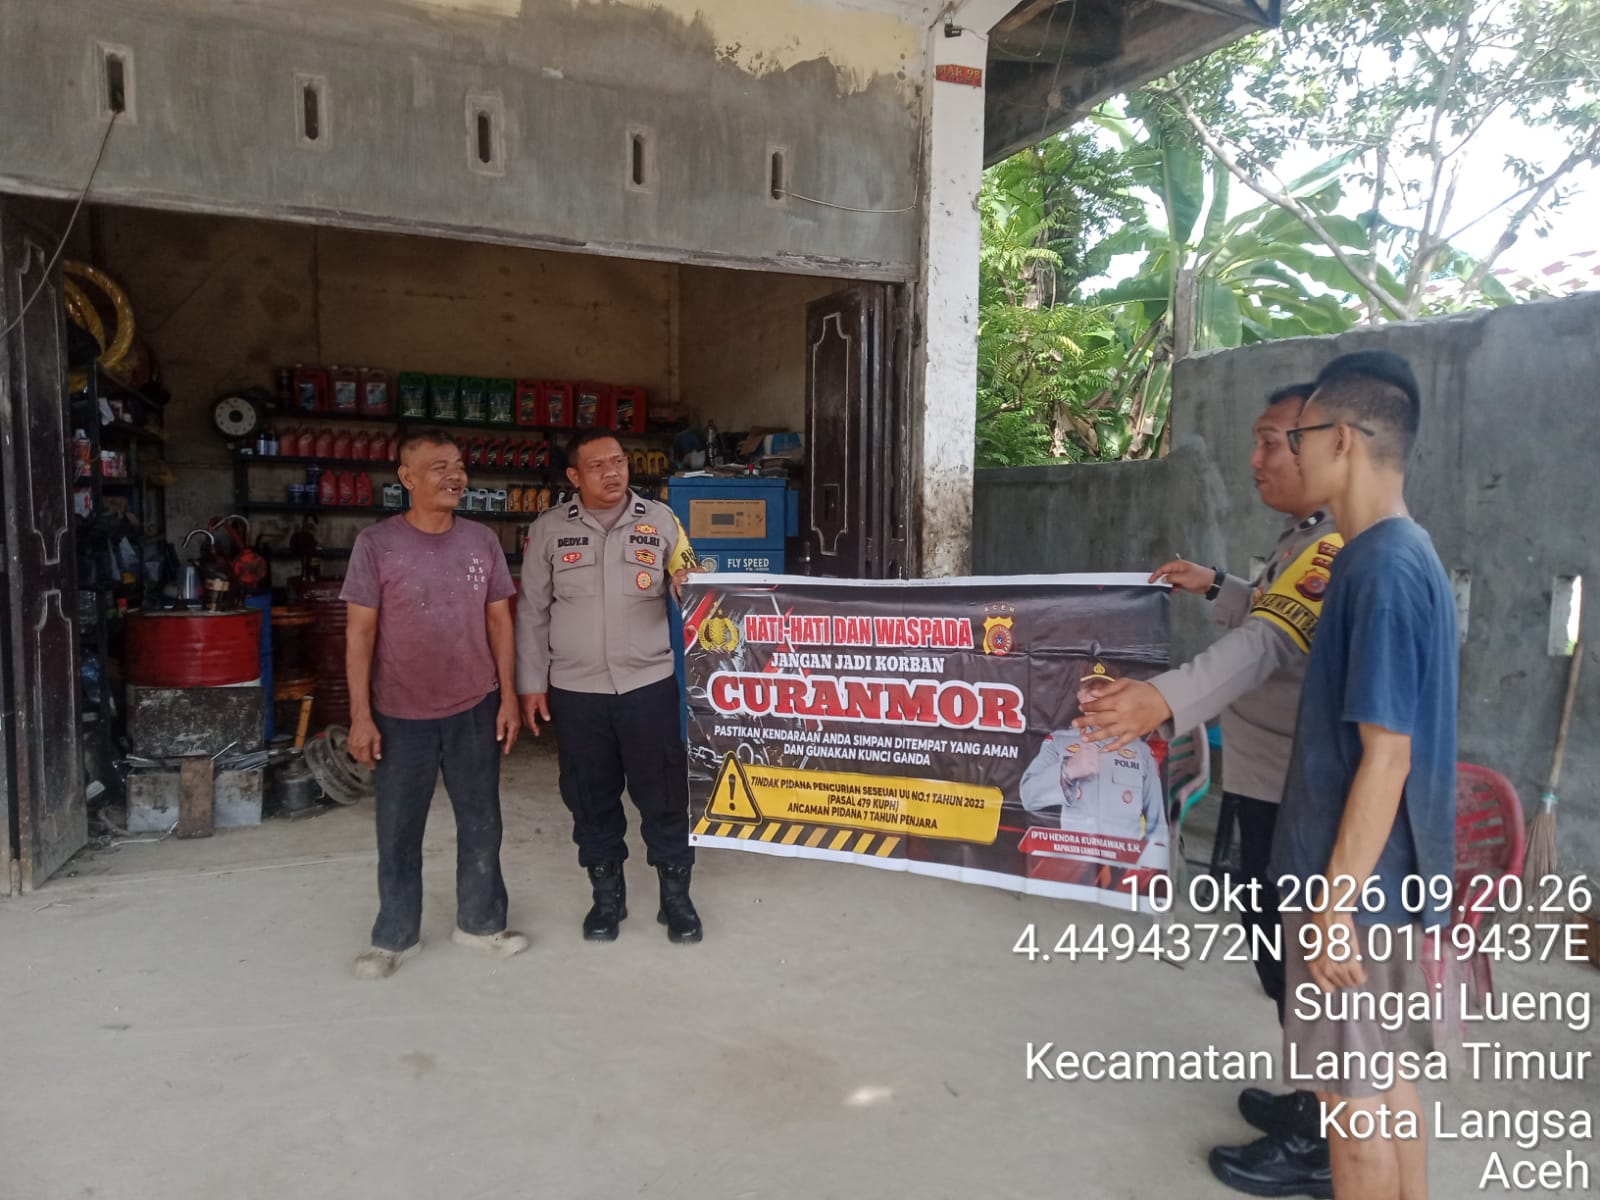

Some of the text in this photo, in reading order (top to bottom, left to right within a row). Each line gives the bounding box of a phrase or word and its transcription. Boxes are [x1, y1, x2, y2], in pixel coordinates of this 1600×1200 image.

[629, 535, 660, 547] POLRI
[727, 558, 770, 569] FLY SPEED
[984, 604, 1015, 613] ACEH
[744, 614, 831, 645] HATI-HATI
[833, 616, 873, 647] DAN
[874, 616, 974, 649] WASPADA
[771, 652, 945, 673] JANGAN JADI KORBAN
[707, 671, 1026, 734] CURANMOR
[714, 725, 1018, 759] PASTIKAN KENDARAAN ANDA SIMPAN DITEMPAT YANG AMAN
[784, 743, 931, 766] DAN GUNAKAN KUNCI GANDA
[1114, 759, 1140, 770] POLRI
[751, 776, 779, 788] TINDAK
[780, 778, 811, 790] PIDANA
[813, 781, 861, 794] PENCURIAN
[911, 790, 930, 802] NO.1
[932, 793, 963, 806] TAHUN
[827, 794, 899, 813] (PASAL 479 KUPH)
[787, 802, 938, 829] ANCAMAN PIDANA 7 TAHUN PENJARA
[1031, 831, 1048, 841] IPTU
[1049, 833, 1080, 844] HENDRA
